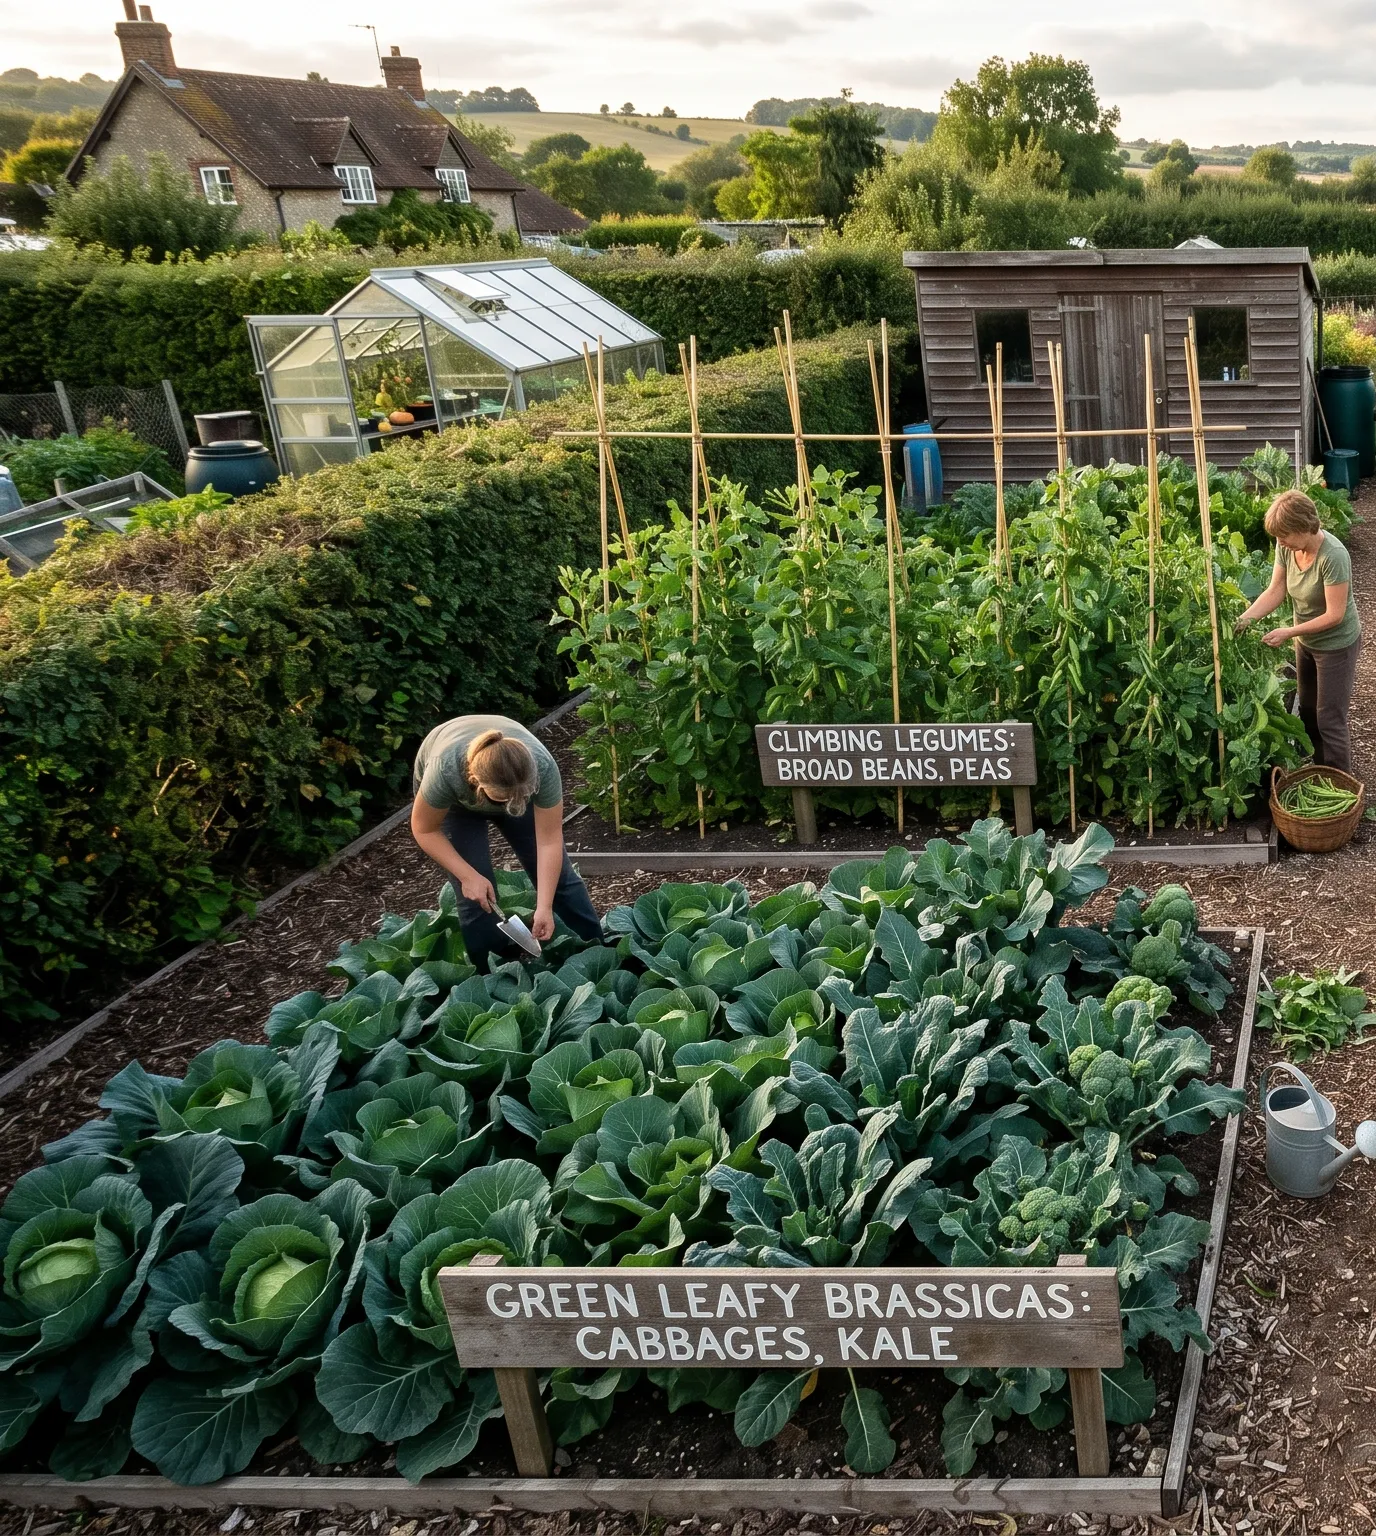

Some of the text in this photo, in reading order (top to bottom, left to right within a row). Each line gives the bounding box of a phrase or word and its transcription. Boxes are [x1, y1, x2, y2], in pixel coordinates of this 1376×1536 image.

[768, 728, 1016, 753] CLIMBING LEGUMES:
[777, 757, 1012, 782] BROAD BEANS, PEAS
[485, 1282, 1091, 1320] GREEN LEAFY BRASSICAS:
[575, 1326, 959, 1366] CABBAGES, KALE
